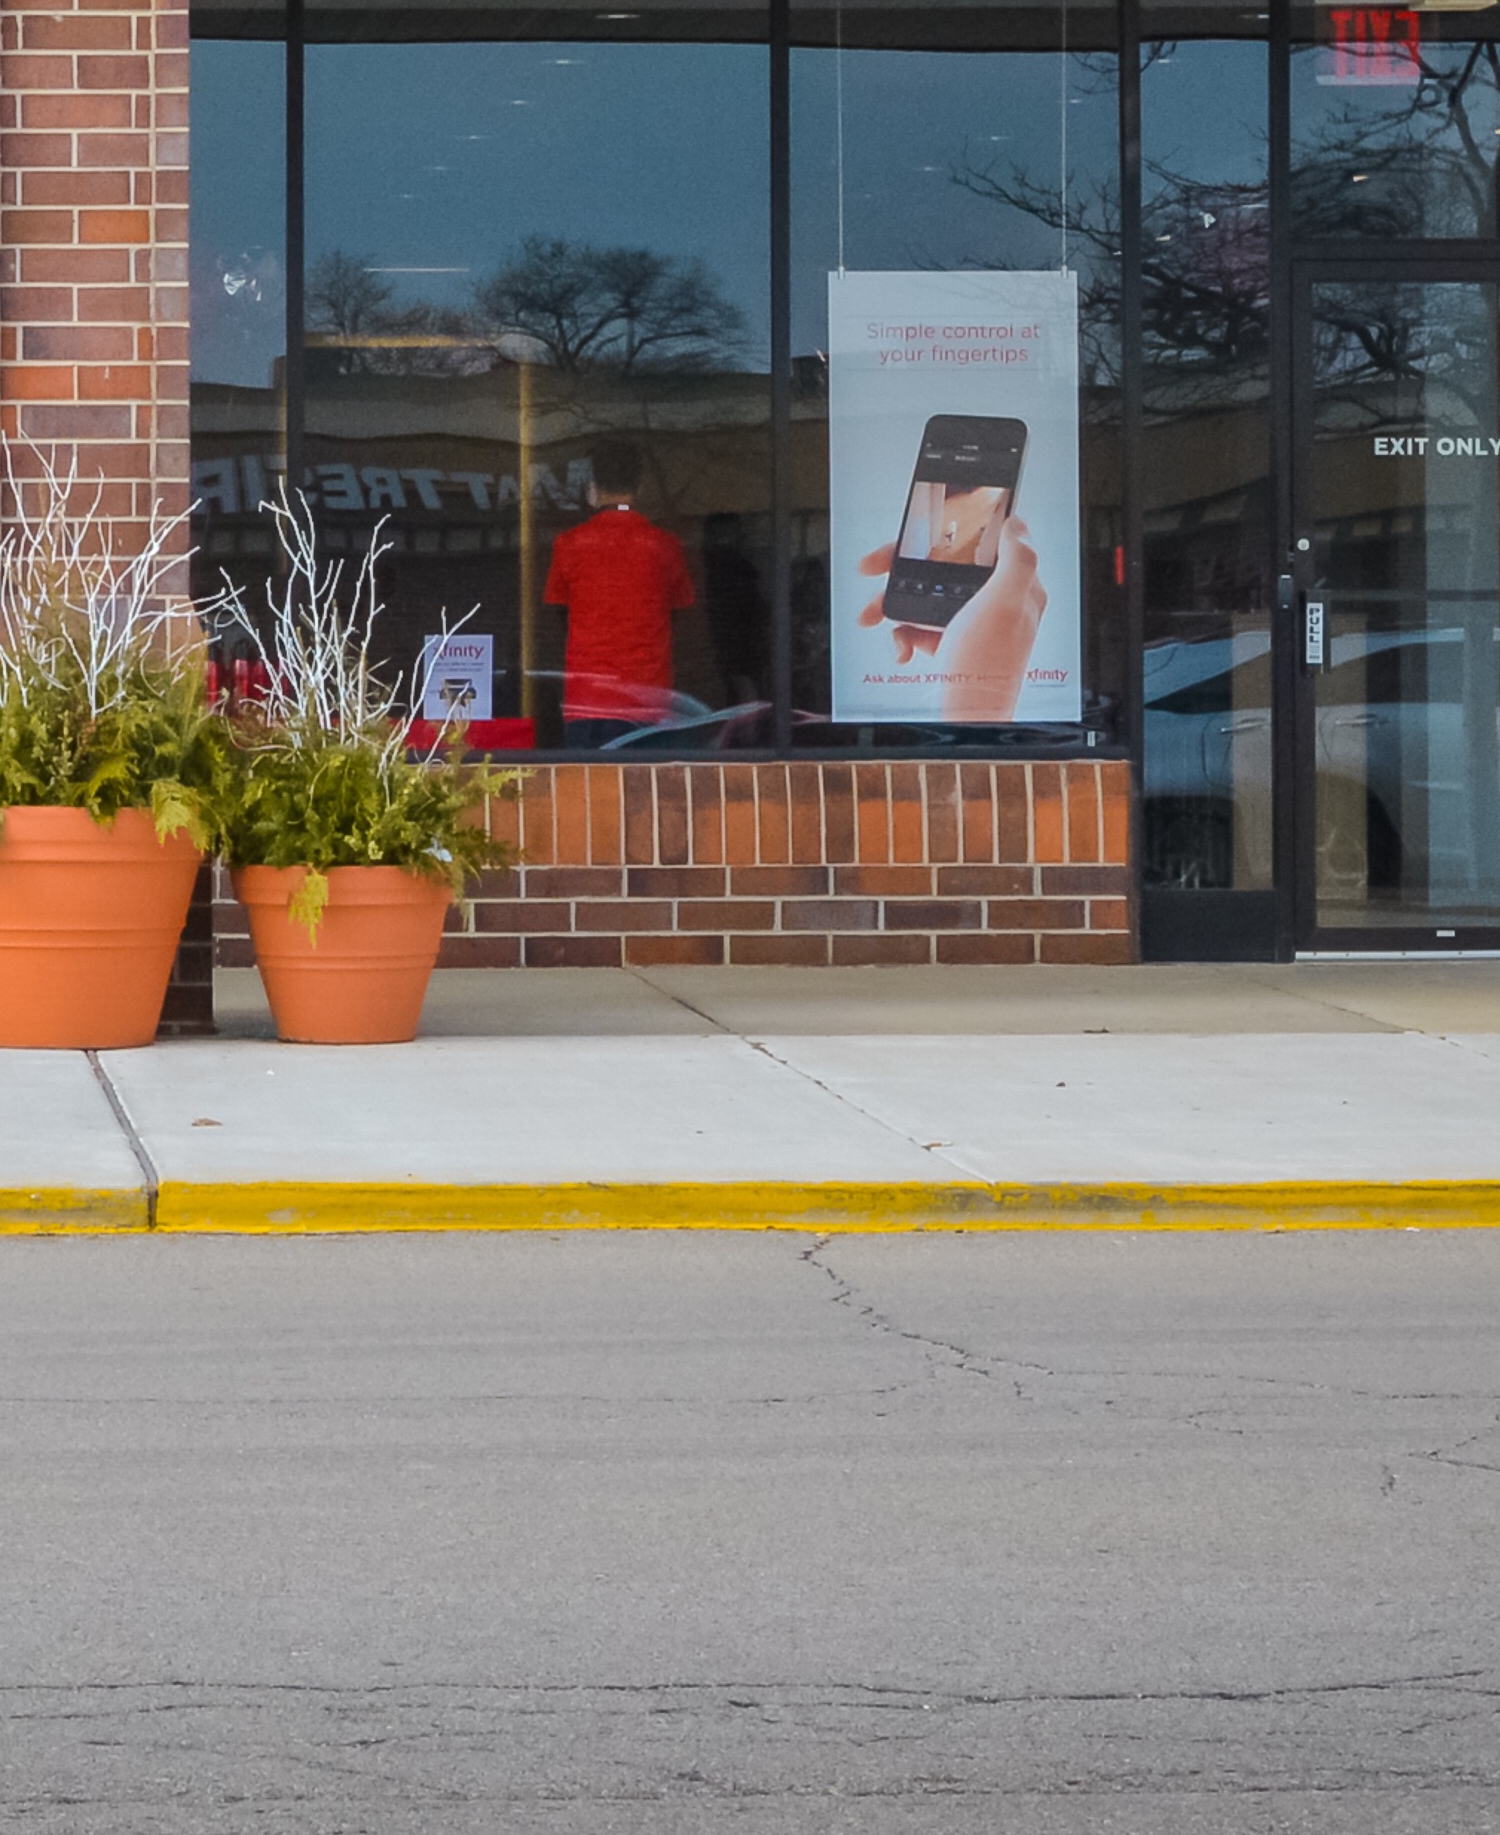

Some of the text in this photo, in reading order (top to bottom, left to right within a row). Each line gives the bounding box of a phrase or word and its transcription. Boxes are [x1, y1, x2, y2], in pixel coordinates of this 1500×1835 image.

[867, 323, 1041, 341] Simple control at
[880, 345, 1028, 365] your fingertips
[1374, 437, 1429, 456] EXIT
[1309, 607, 1320, 643] PULL
[862, 674, 884, 684] Ask
[887, 674, 921, 684] about
[1025, 668, 1069, 683] xfinity
